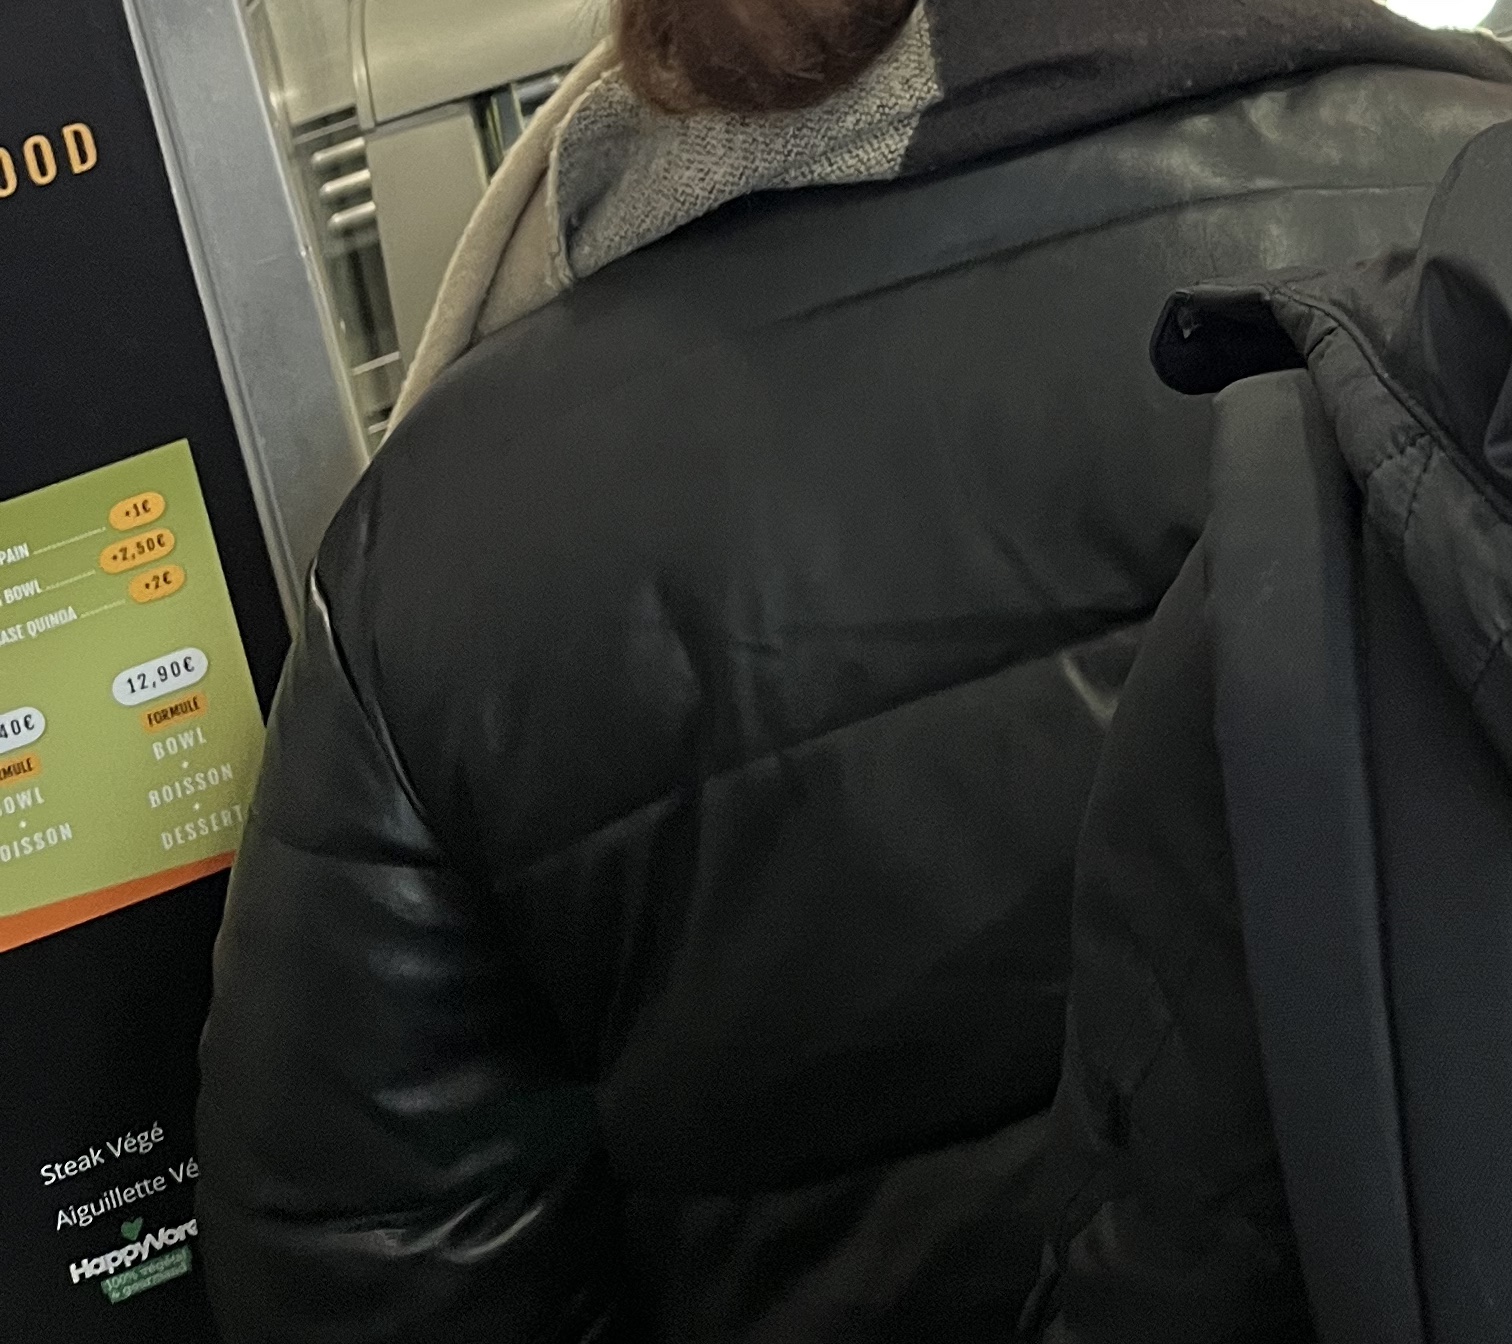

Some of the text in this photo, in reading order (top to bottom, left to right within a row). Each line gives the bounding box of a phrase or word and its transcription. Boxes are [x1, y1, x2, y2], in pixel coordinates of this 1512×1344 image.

[4, 578, 43, 604] BOWL
[126, 656, 195, 694] 12,90€
[147, 696, 201, 728] FORMULE
[152, 726, 207, 761] BOWL
[148, 762, 234, 809] BOISSON
[40, 1120, 165, 1186] Steak Végé
[56, 1174, 167, 1231] Aiguillette
